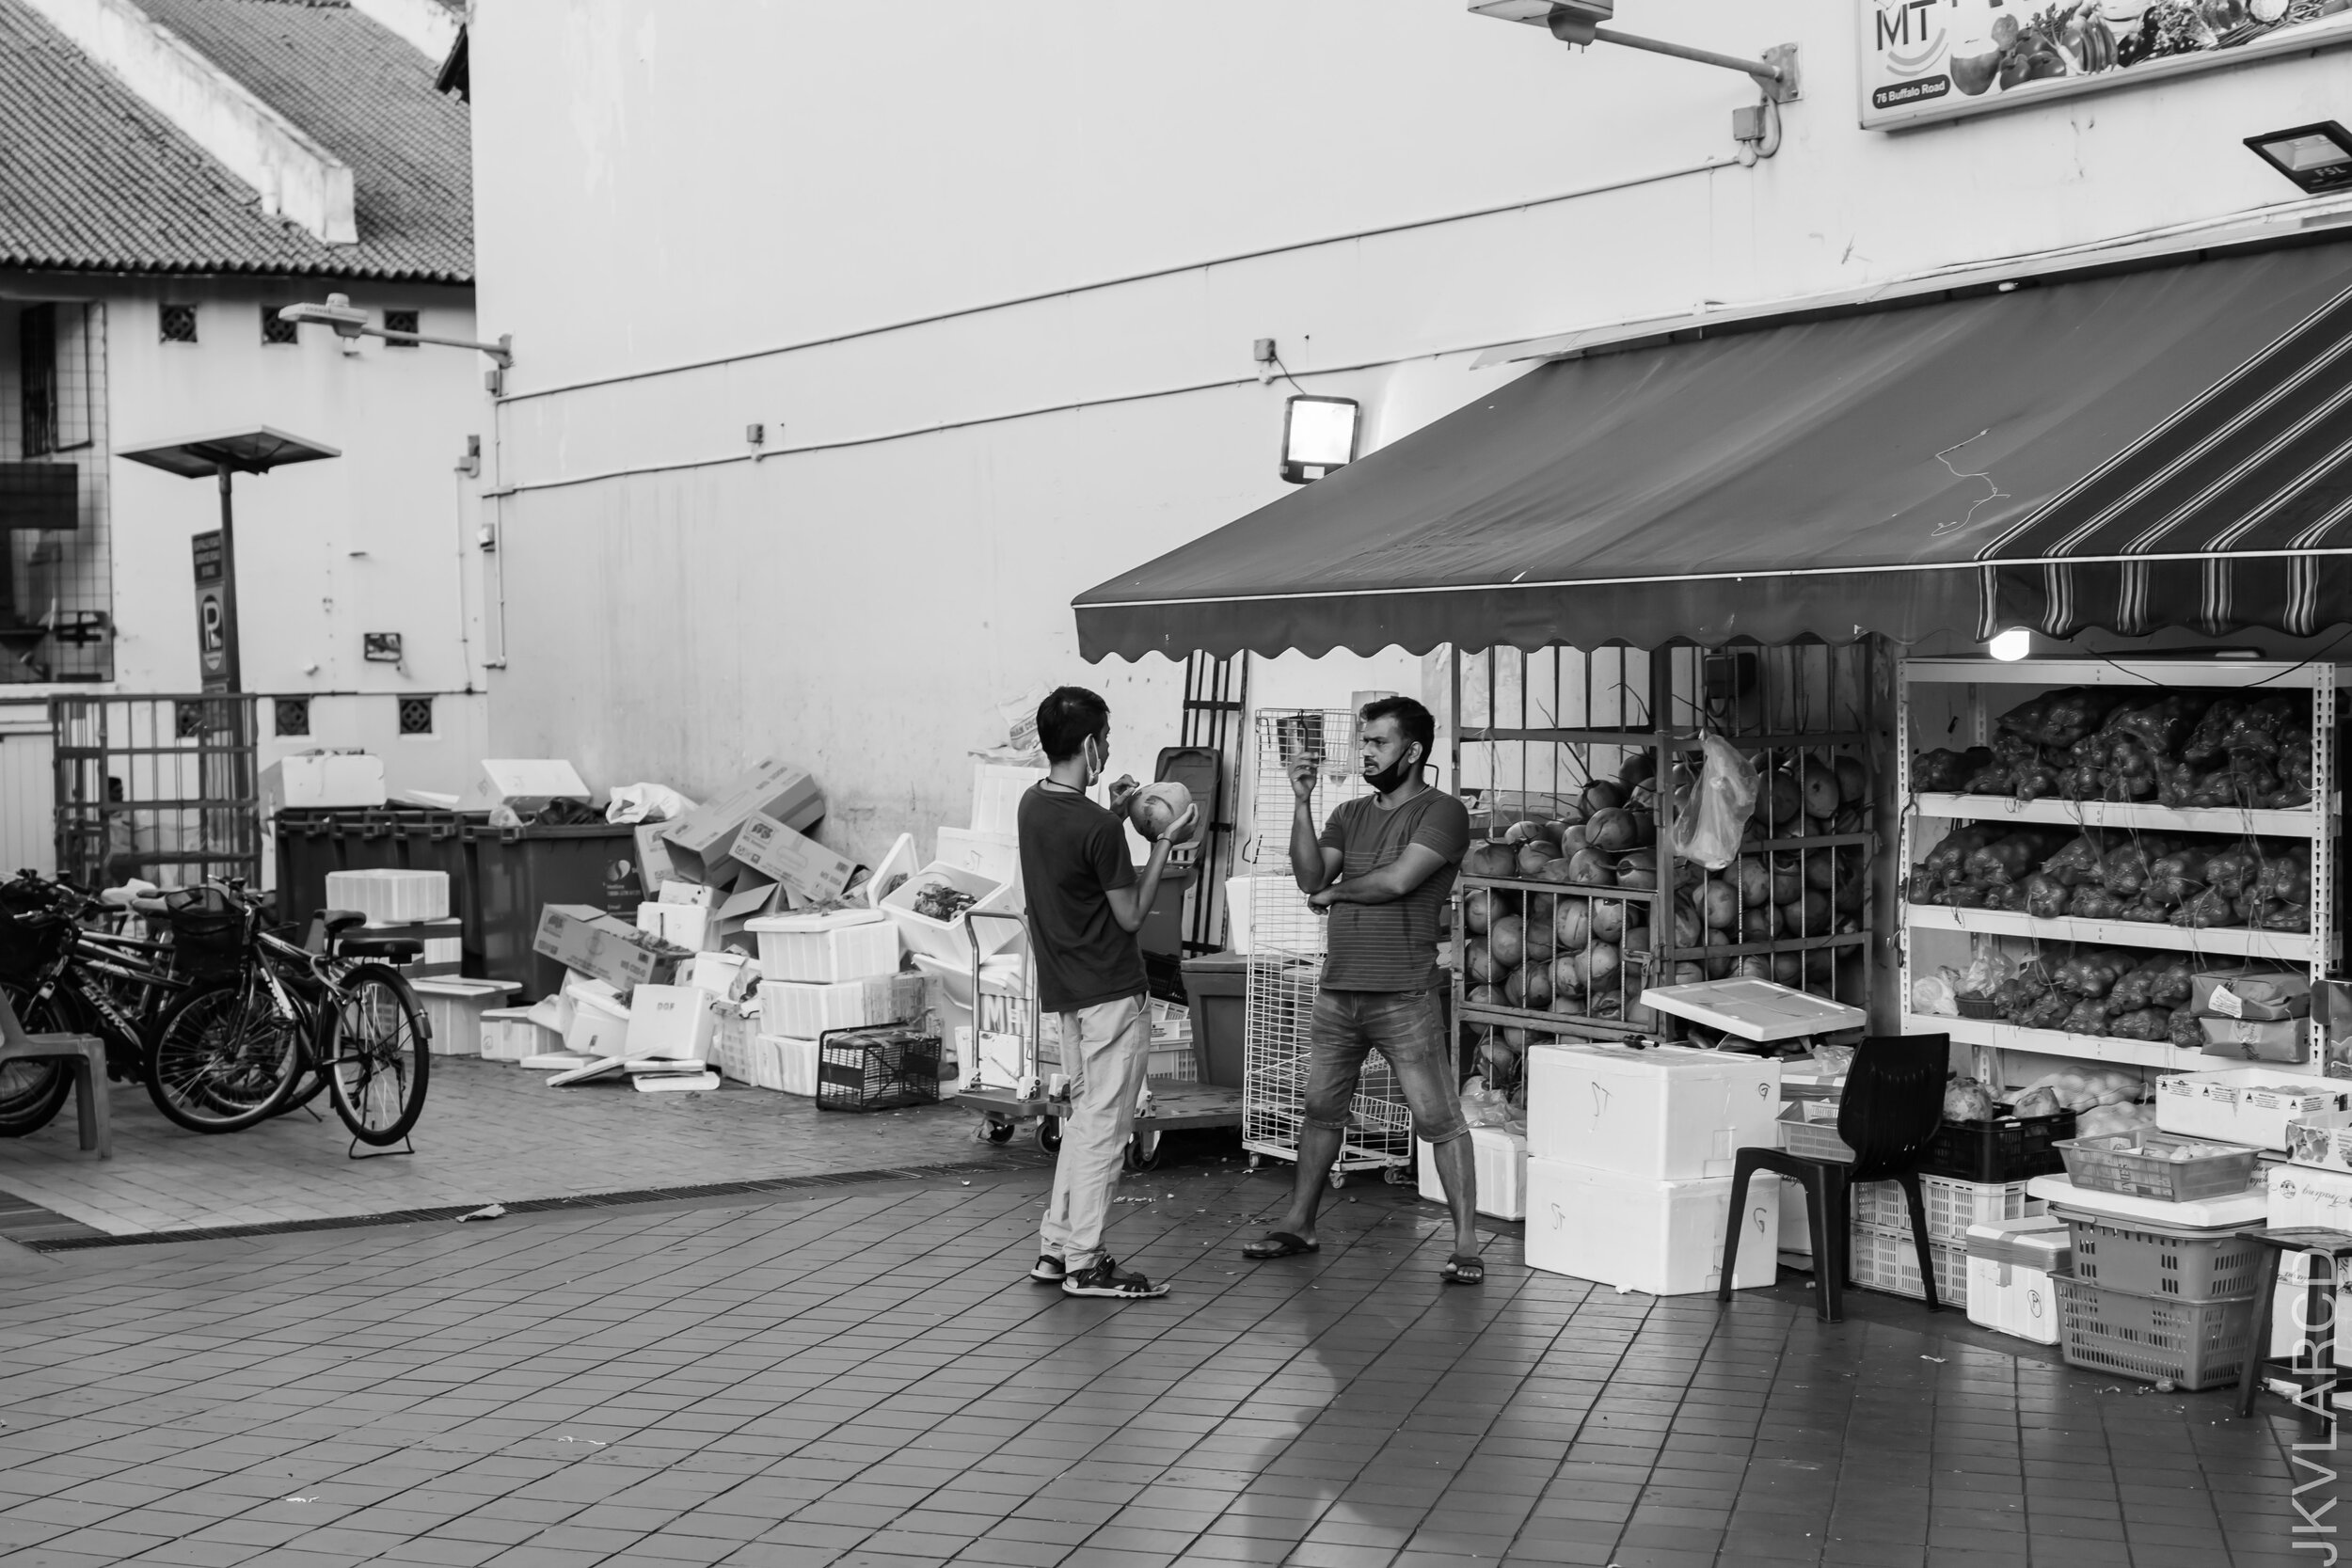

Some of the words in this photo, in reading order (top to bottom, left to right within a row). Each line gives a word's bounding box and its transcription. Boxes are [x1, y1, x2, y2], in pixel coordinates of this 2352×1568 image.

[1877, 0, 1938, 51] MT
[1876, 92, 1888, 103] 76
[1888, 86, 1920, 102] Buffalo
[1921, 80, 1946, 95] Road
[2314, 166, 2347, 177] FSL
[2302, 1183, 2348, 1208] Trading
